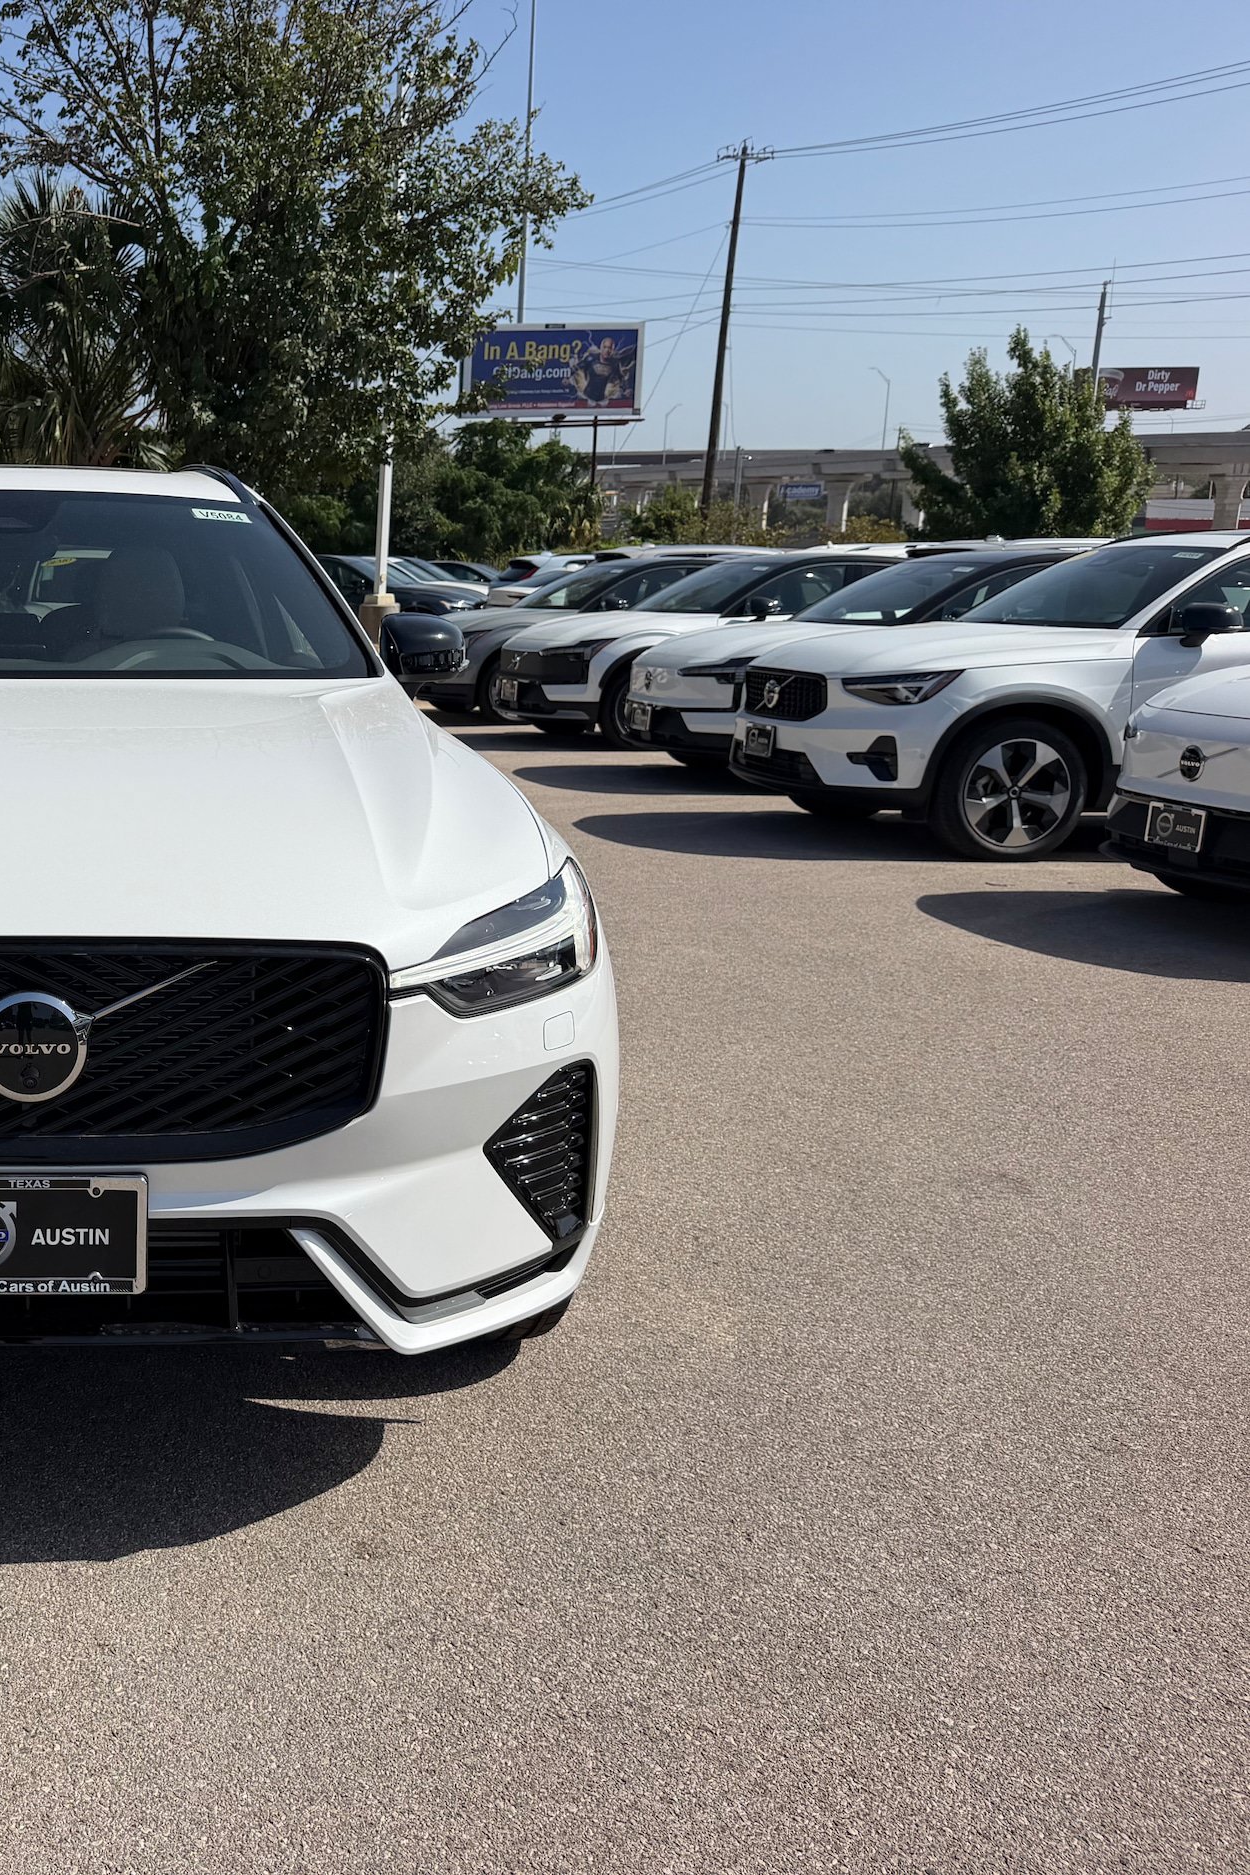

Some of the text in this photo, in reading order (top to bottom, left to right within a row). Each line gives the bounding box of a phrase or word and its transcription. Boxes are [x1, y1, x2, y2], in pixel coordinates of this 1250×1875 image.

[484, 340, 582, 363] In A Bang?
[1147, 369, 1171, 382] Dirty
[1135, 381, 1180, 395] Dr Pepper
[1175, 824, 1196, 835] AUSTIN
[8, 1180, 51, 1189] TEXAS
[31, 1228, 110, 1246] AUSTIN
[37, 1280, 54, 1293] of
[58, 1280, 111, 1293] Austin
